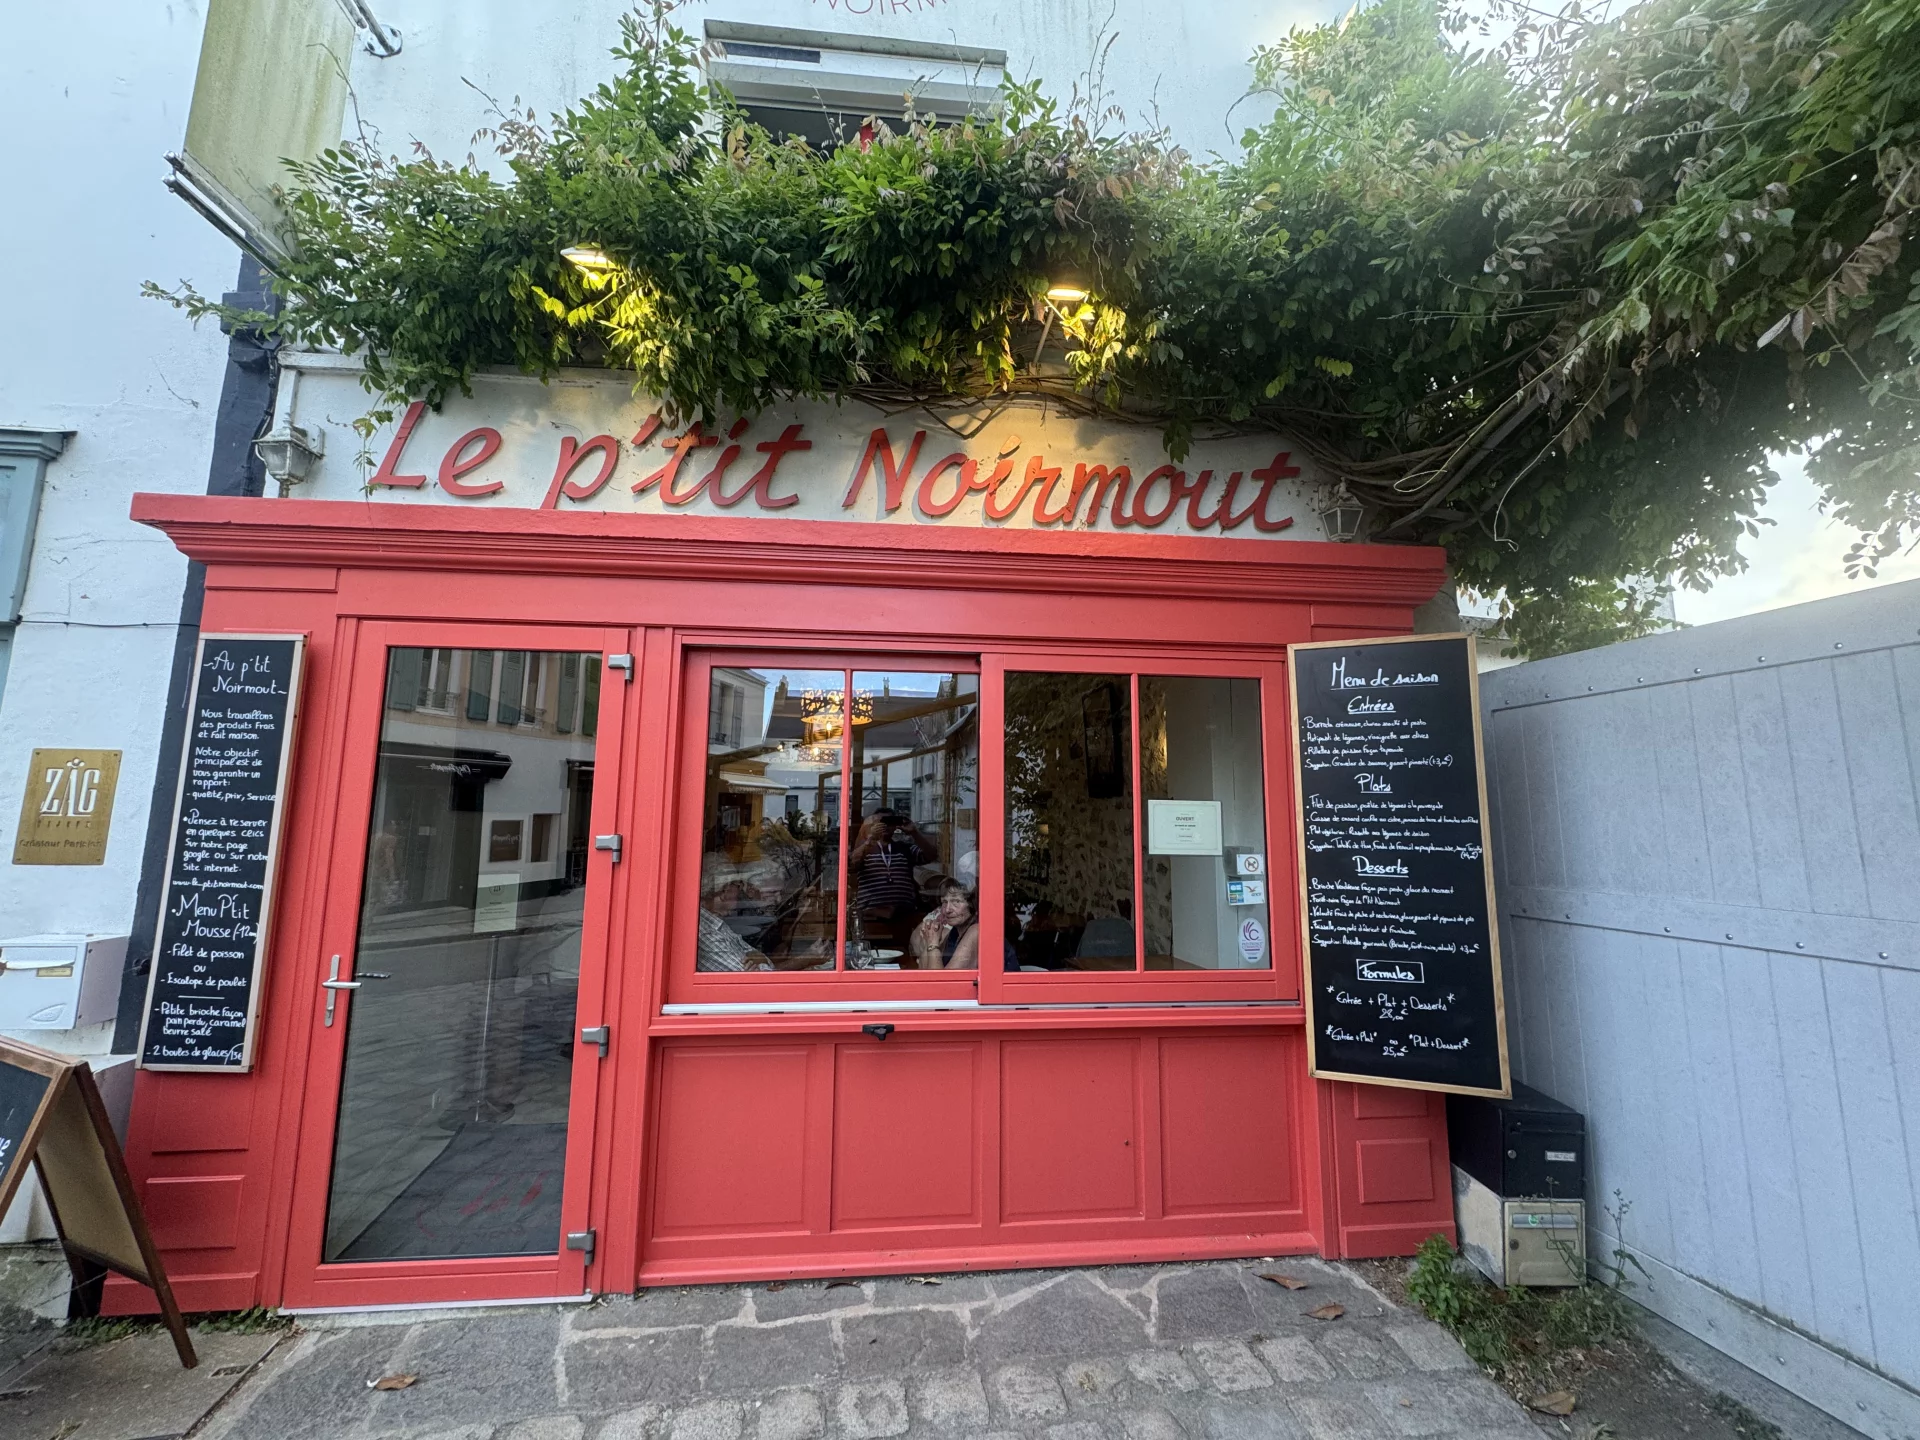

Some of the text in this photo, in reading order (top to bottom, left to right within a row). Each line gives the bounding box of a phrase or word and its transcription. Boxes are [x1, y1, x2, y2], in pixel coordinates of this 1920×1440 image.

[368, 401, 1301, 532] Le p'tit Noirmout
[212, 650, 235, 672] Au
[1331, 657, 1439, 689] Menu de saison
[212, 674, 277, 695] Noirmout
[1347, 695, 1395, 712] Entrées
[201, 708, 274, 720] Nous travaillons
[200, 721, 214, 729] des
[216, 721, 253, 733] produits
[198, 730, 209, 739] et
[1333, 733, 1341, 741] de
[195, 746, 221, 757] Notre
[1332, 747, 1340, 755] de
[194, 757, 263, 768] principal est de
[192, 769, 211, 777] vous
[213, 769, 250, 780] garantir
[1354, 772, 1392, 792] Plats
[1325, 800, 1335, 809] de
[220, 817, 227, 826] à
[186, 828, 265, 840] en quelques clics
[200, 841, 225, 849] notre
[226, 842, 248, 853] page
[183, 850, 210, 862] google
[214, 852, 226, 860] ou
[1352, 855, 1410, 875] Desserts
[175, 892, 217, 918] Menu
[181, 919, 231, 938] Mousse
[172, 942, 245, 962] Filet de poisson
[193, 964, 207, 973] ou
[1359, 961, 1415, 981] Formules
[167, 972, 247, 990] Escalope de poulet
[1336, 991, 1448, 1011] Entrée Plat Desserts
[161, 1002, 185, 1015] Petite
[189, 1003, 220, 1017] brioche
[165, 1017, 183, 1028] pain
[209, 1018, 247, 1028] caramel
[163, 1026, 213, 1037] beurre salé
[185, 1037, 197, 1045] ou
[162, 1045, 190, 1057] boules
[191, 1047, 203, 1057] de
[202, 1047, 228, 1060] glaces
